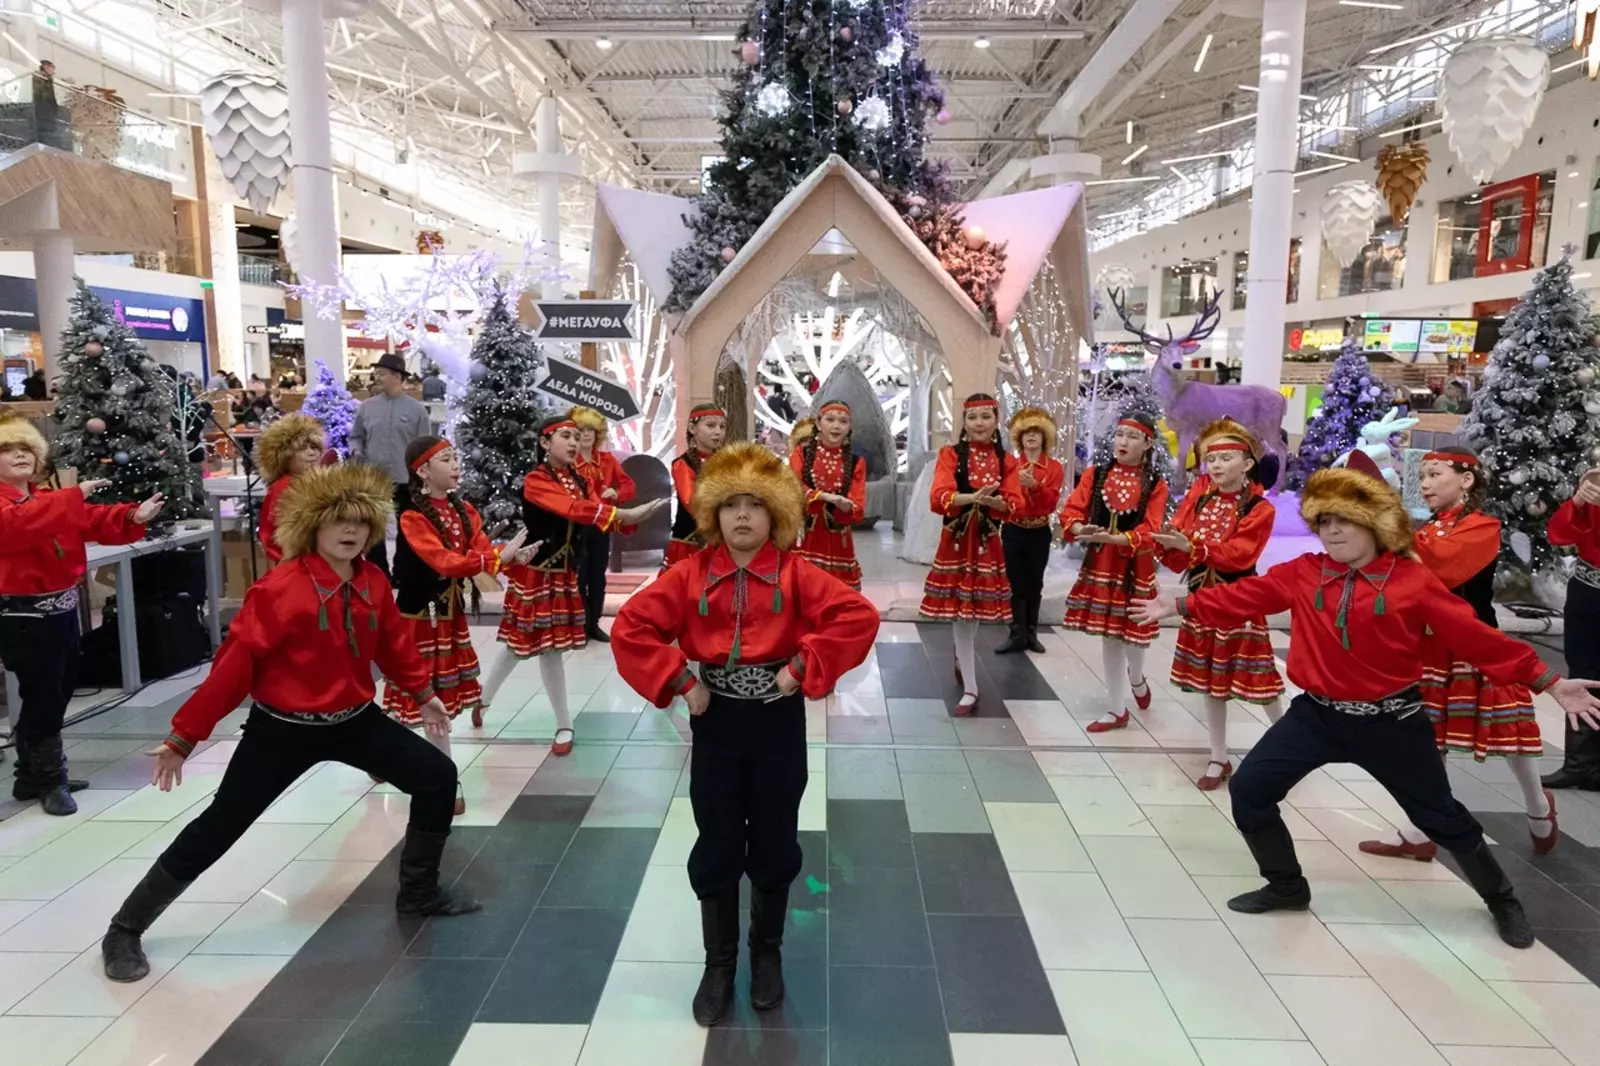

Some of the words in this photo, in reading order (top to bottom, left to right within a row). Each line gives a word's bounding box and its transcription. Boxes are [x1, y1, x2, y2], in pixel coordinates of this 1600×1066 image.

[548, 316, 622, 329] #МЕГАУФА
[575, 375, 603, 393] ДОМ
[546, 378, 577, 397] ДЕДА
[578, 390, 625, 417] МОРОЗА
